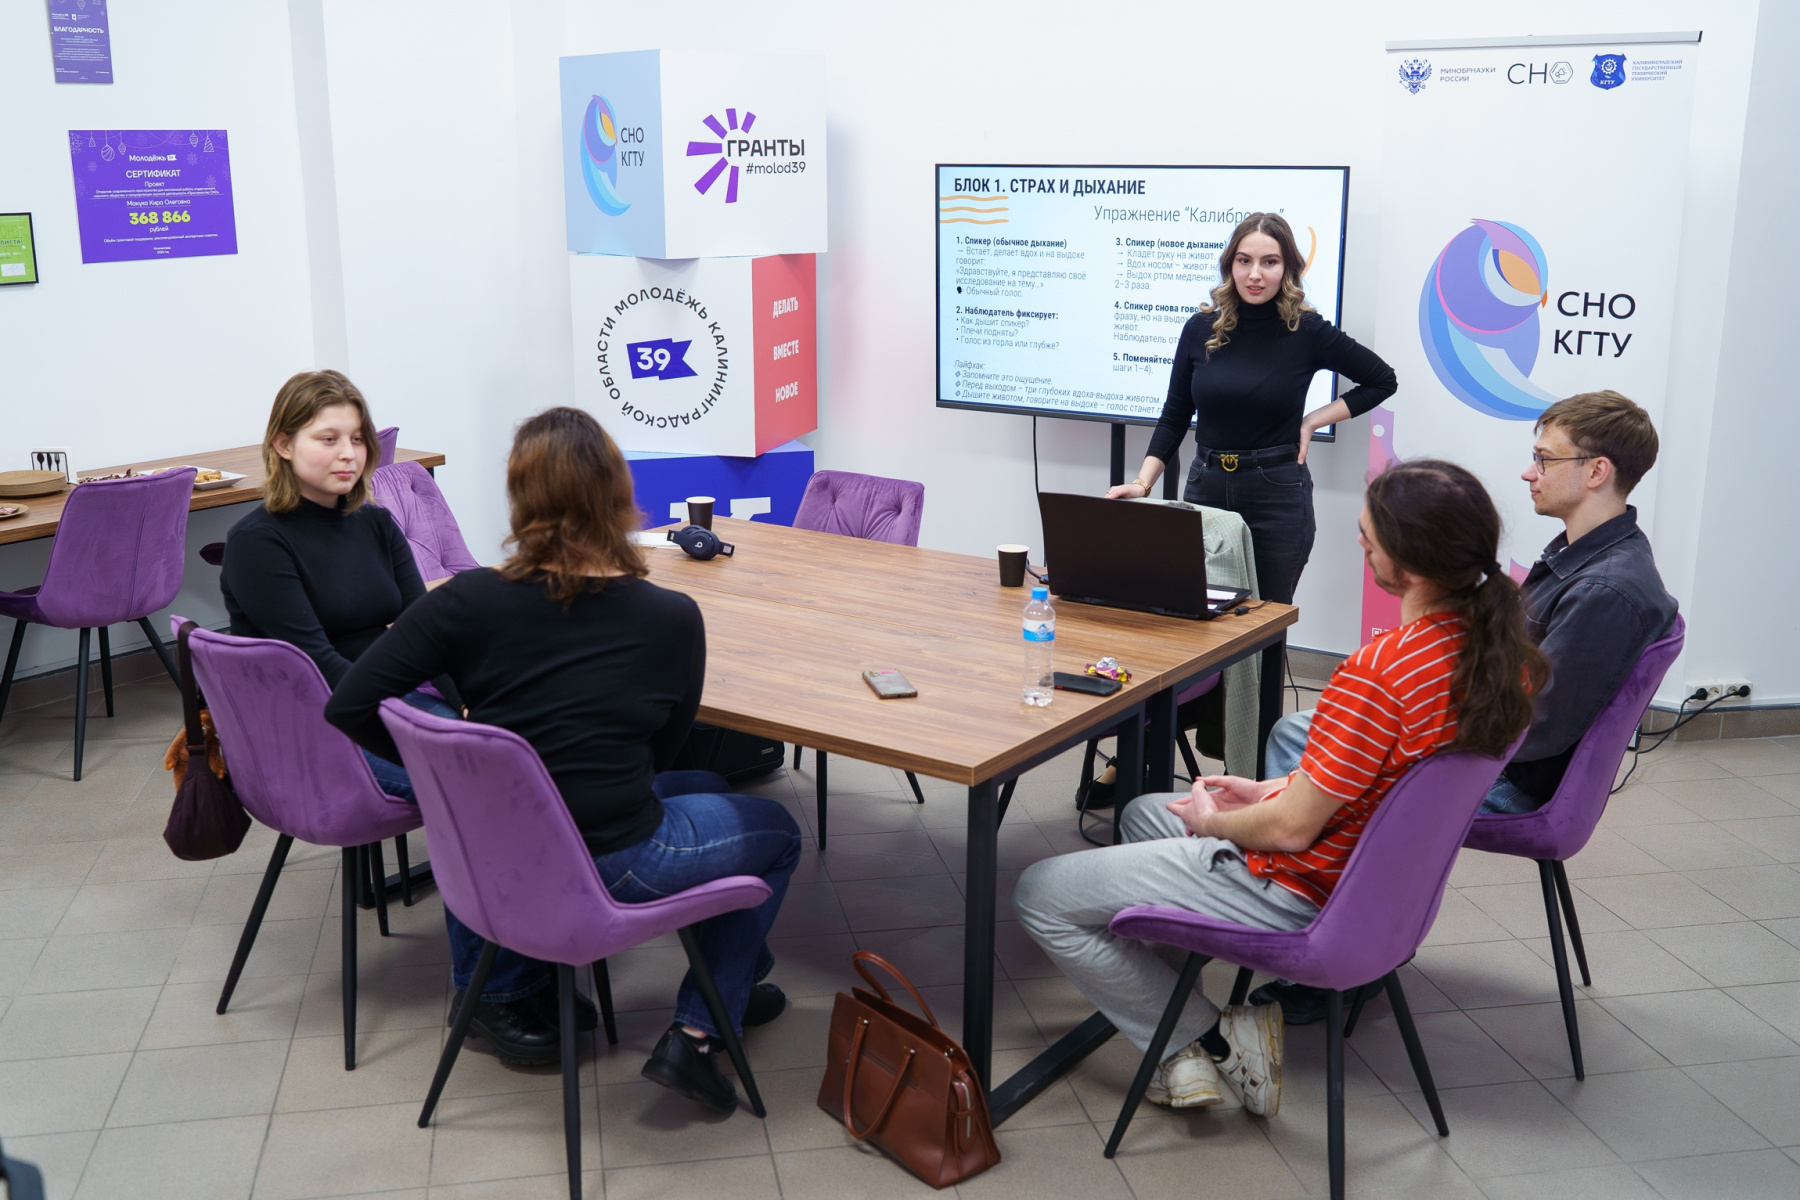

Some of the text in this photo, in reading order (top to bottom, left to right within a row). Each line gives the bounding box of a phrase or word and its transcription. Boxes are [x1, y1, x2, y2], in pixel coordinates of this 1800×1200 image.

[54, 26, 104, 34] БЛАГОДАРНОСТЬ
[620, 127, 645, 144] СНО
[727, 139, 805, 157] ГРАНТЫ
[621, 150, 645, 167] КГТУ
[125, 169, 181, 179] СЕРТИФИКАТ
[746, 161, 807, 175] #molod39
[954, 178, 1146, 197] БЛОК 1. СТРАХ И ДЫХАНИЕ
[129, 210, 191, 225] 368 866
[1094, 205, 1181, 224] Упражнение
[956, 236, 1067, 249] 1. Спикер (обычное дыхание)
[1115, 237, 1124, 246] 3.
[1125, 237, 1156, 248] Спикер
[1157, 238, 1185, 249] (новое
[993, 248, 1019, 258] делает
[1020, 249, 1038, 259] вдох
[1046, 249, 1055, 258] на
[1056, 250, 1085, 260] выдохе
[1127, 248, 1155, 259] Кладёт
[1157, 250, 1175, 260] руку
[1176, 251, 1187, 259] на
[1126, 258, 1146, 269] Вдох
[1147, 261, 1173, 270] носом
[1182, 262, 1208, 271] живот
[955, 276, 1006, 287] исследование
[1007, 279, 1016, 287] на
[1017, 269, 1067, 280] представляю
[1126, 269, 1152, 280] Выдох
[1153, 271, 1174, 281] ртом
[966, 286, 1000, 296] Обычный
[614, 287, 708, 320] МОЛОДЁЖЬ
[773, 296, 799, 319] ДЕЛАТЬ
[1114, 300, 1122, 310] 4.
[1123, 300, 1154, 313] Спикер
[1155, 303, 1179, 313] снова
[1557, 291, 1636, 319] СНО
[956, 305, 1059, 321] 2. Наблюдатель фиксирует:
[1141, 313, 1151, 322] но
[1152, 314, 1163, 323] на
[960, 315, 1030, 329] Как дышит спикер?
[960, 325, 1019, 338] Плечи подняты?
[1113, 332, 1167, 344] Наблюдатель
[773, 339, 799, 361] ВМЕСТЕ
[960, 335, 1060, 351] Голос из горла или глубже?
[1554, 329, 1633, 358] КГТУ
[597, 316, 621, 400] ОБЛАСТИ
[636, 347, 671, 371] 39
[1112, 352, 1121, 361] 5.
[1112, 363, 1133, 372] шаги
[621, 321, 729, 429] КАЛИНИНГРАДСКОЙ
[961, 369, 1000, 381] Запомните
[1001, 373, 1014, 383] это
[775, 381, 798, 403] НОВОЕ
[961, 379, 984, 390] Перед
[984, 382, 1017, 393] выходом
[1025, 386, 1037, 394] три
[1038, 386, 1071, 397] глубоких
[961, 389, 991, 400] Дышите
[1026, 394, 1059, 406] говорите
[1059, 398, 1069, 407] на
[1070, 399, 1099, 410] выдохе
[1106, 402, 1129, 413] голос
[1129, 404, 1155, 414] станет
